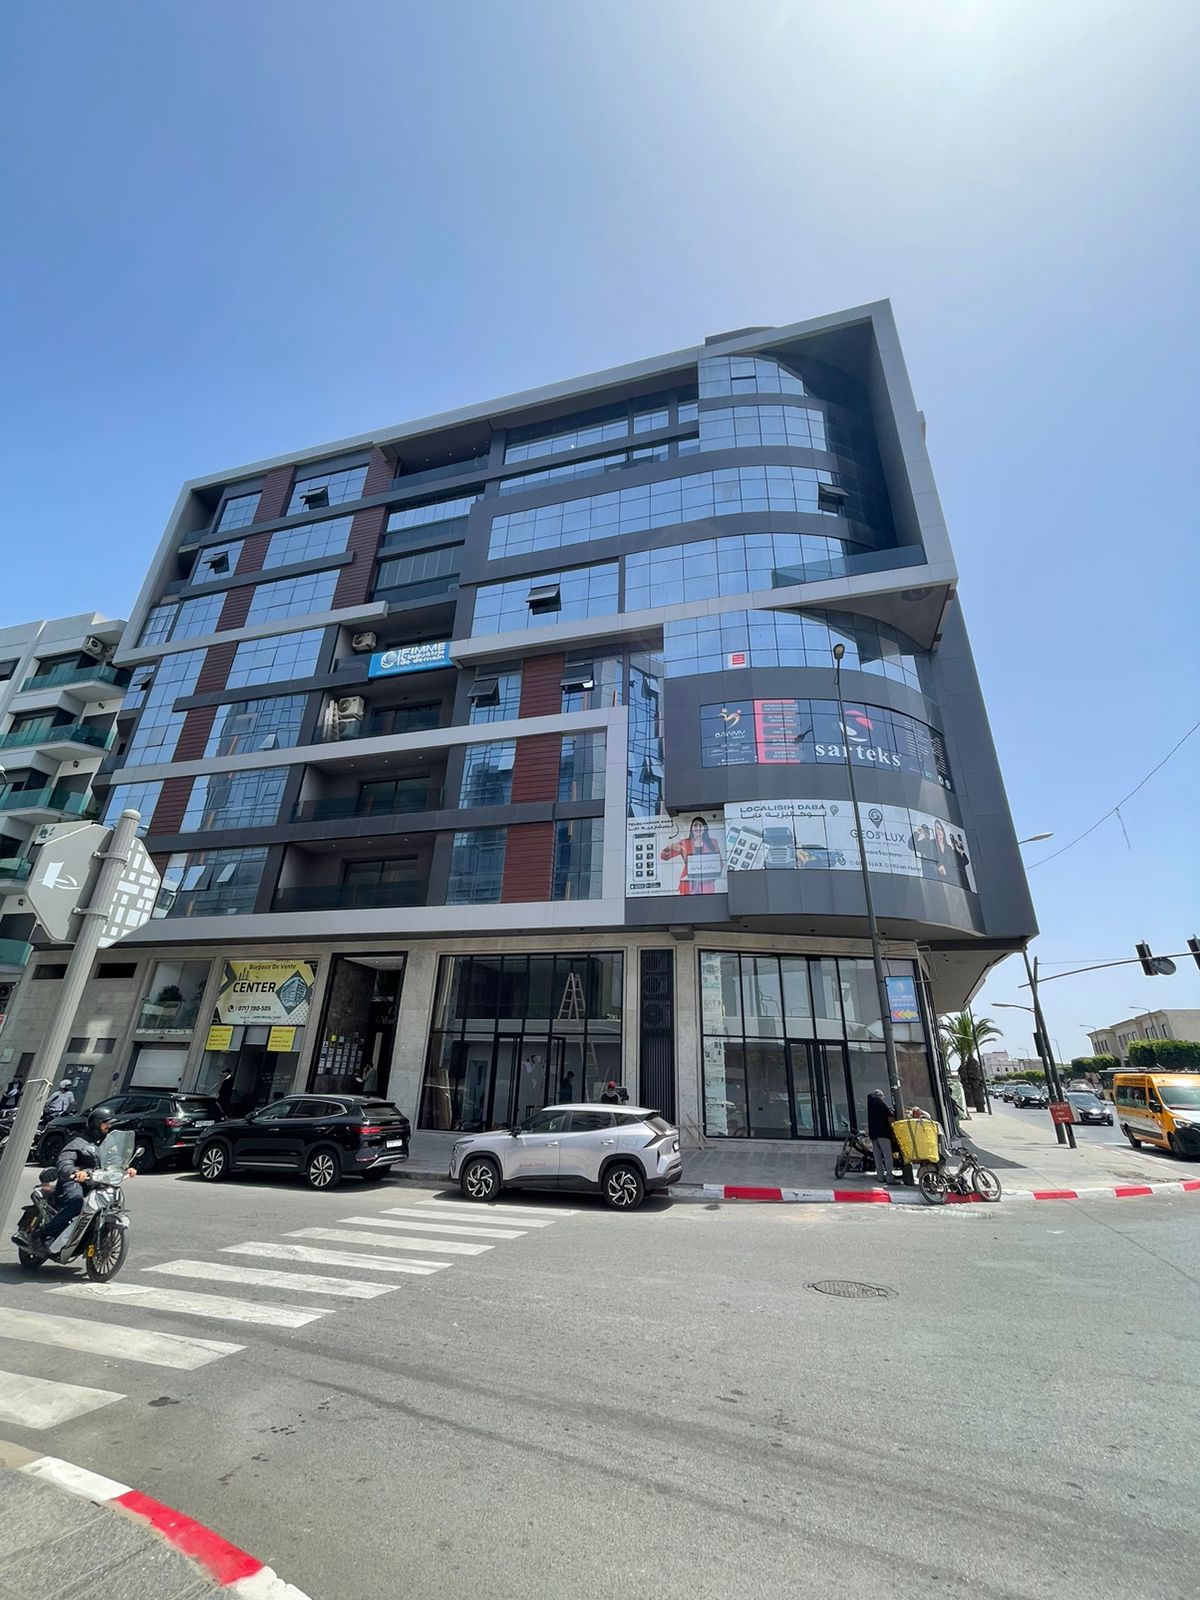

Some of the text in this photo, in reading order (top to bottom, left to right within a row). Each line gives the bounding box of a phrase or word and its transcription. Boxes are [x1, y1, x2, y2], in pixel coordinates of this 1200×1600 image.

[815, 744, 901, 767] sarteks
[740, 804, 794, 813] LOCALISIH
[233, 982, 276, 993] CENTER
